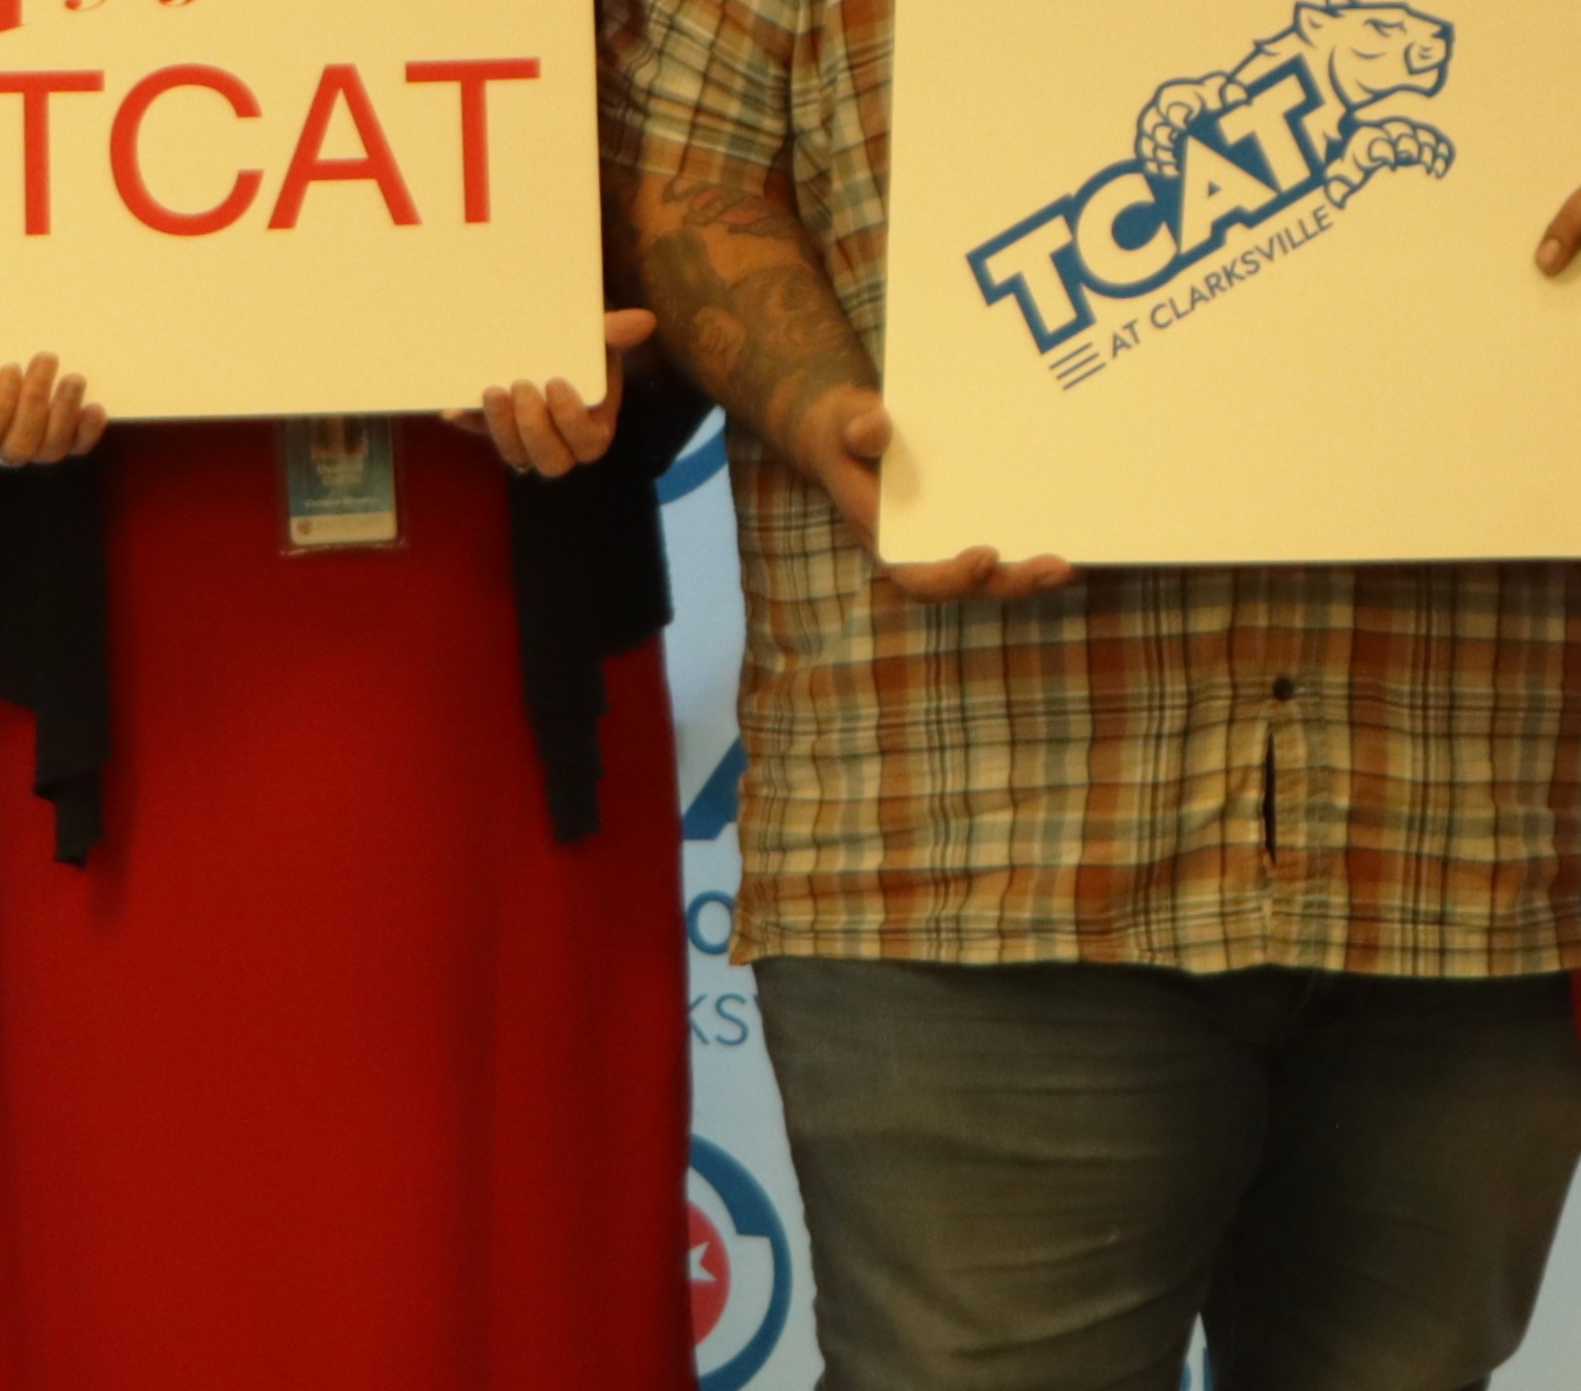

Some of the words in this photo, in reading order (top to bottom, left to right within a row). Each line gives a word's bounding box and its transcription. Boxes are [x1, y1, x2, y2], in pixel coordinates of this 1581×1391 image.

[965, 52, 1326, 355] TCAT
[1110, 319, 1142, 359] AT
[1150, 203, 1333, 331] CLARKSVILLE
